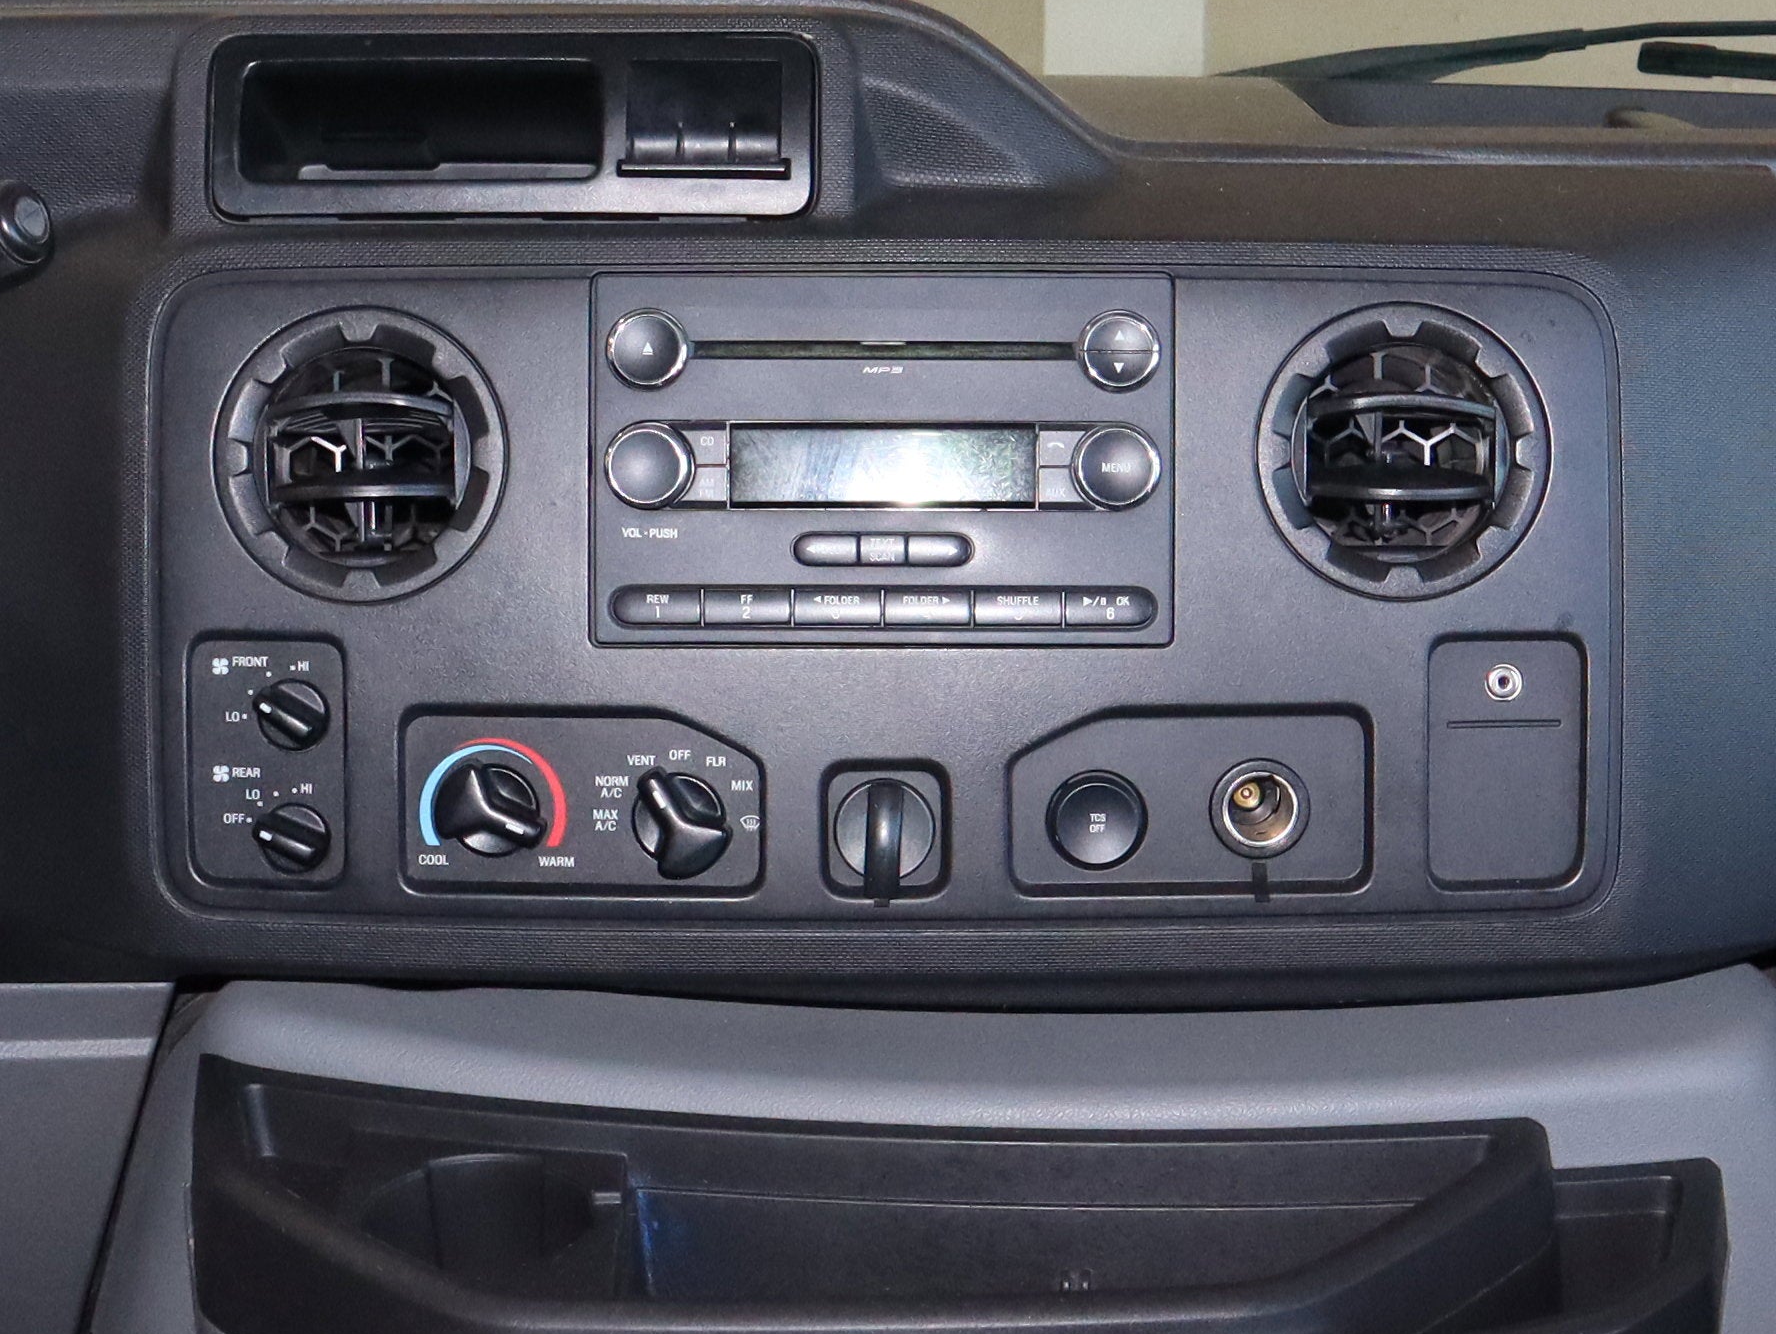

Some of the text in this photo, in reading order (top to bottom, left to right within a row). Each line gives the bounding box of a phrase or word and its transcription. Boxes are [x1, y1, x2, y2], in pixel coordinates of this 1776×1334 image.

[700, 436, 715, 447] CD
[1101, 462, 1132, 474] MENU
[646, 594, 670, 605] REW
[739, 594, 754, 605] FF
[822, 595, 861, 606] FOLDER
[902, 596, 941, 606] FOLDER
[996, 596, 1040, 607] SHUFFLE
[1115, 596, 1131, 607] OK
[654, 606, 661, 619] 1
[742, 606, 752, 619] 2
[232, 656, 269, 669] FRONT
[298, 661, 311, 673] HI
[225, 711, 241, 723] LO
[627, 754, 656, 767] VENT
[669, 749, 692, 762] OFF
[705, 755, 727, 768] FLR
[232, 766, 261, 779] REAR
[595, 774, 629, 787] NORM
[731, 779, 754, 792] MIX
[245, 788, 261, 801] LO
[300, 783, 313, 796] HI
[600, 786, 623, 799] A/C
[223, 812, 246, 825] OFF
[592, 809, 619, 821] MAX
[1089, 813, 1106, 823] TCS
[594, 820, 617, 833] A/C
[1089, 824, 1106, 833] OFF
[418, 854, 450, 867] COOL
[539, 854, 576, 868] WARM
